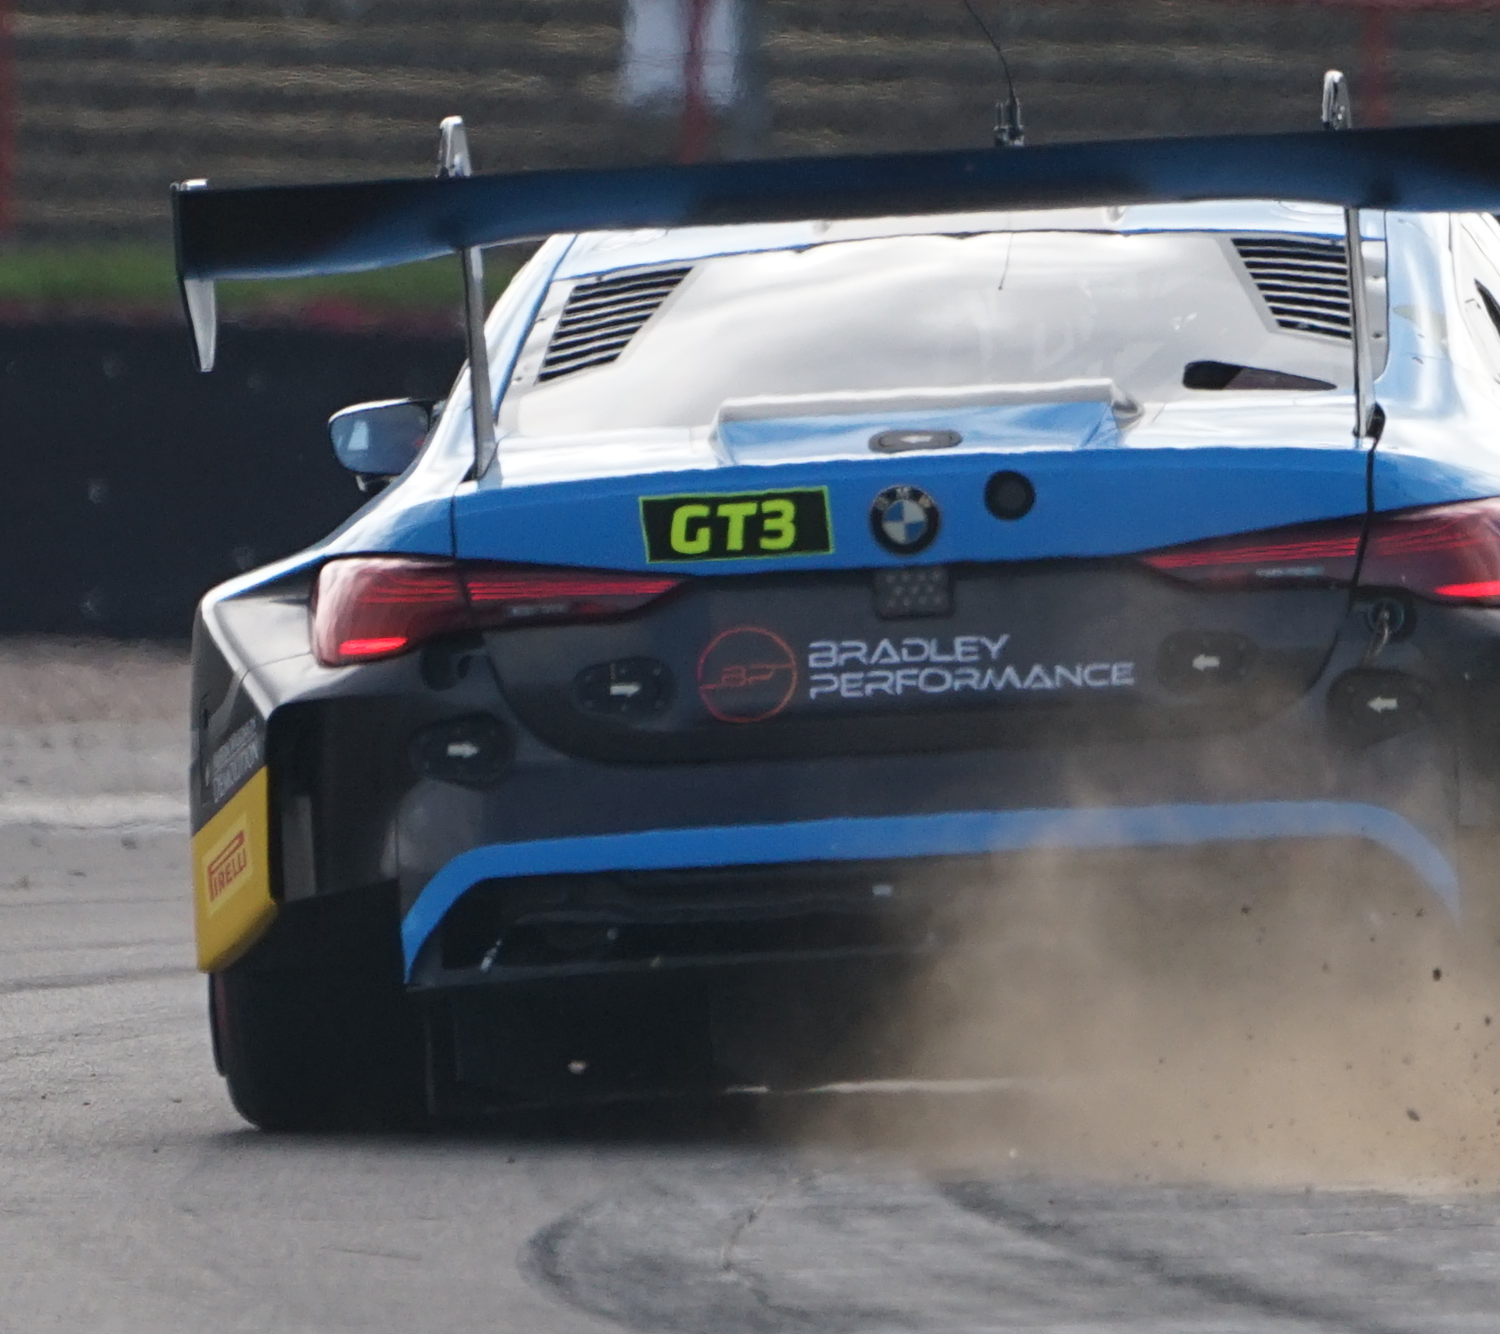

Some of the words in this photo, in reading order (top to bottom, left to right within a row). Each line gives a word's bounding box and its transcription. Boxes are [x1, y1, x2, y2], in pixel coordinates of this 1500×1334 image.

[669, 498, 797, 555] GT3
[808, 633, 1010, 668] BRADLEY
[808, 661, 1136, 701] PERFORMANCE
[207, 830, 247, 902] PIRELLI
